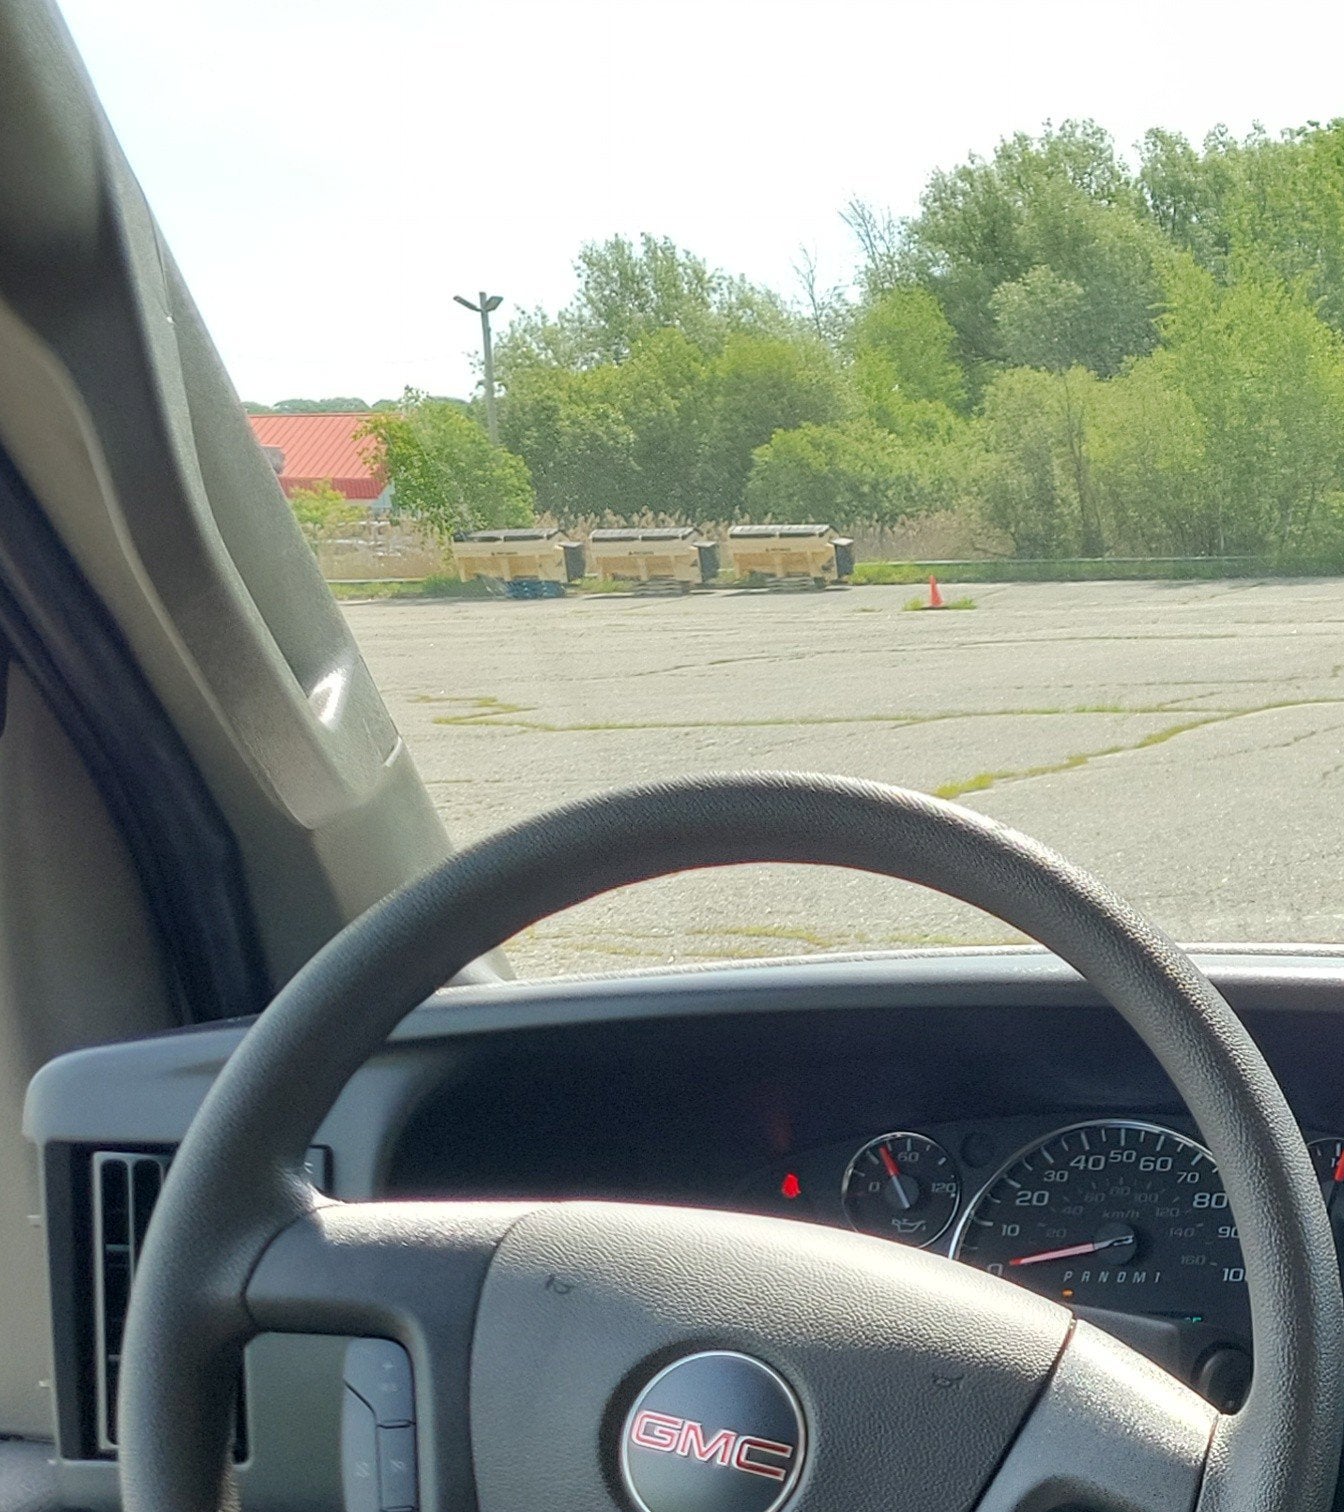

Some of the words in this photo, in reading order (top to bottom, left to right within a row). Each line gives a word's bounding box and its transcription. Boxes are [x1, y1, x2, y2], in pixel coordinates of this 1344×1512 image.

[897, 1151, 920, 1162] 60
[1070, 1155, 1106, 1171] 40
[1109, 1150, 1137, 1163] 50
[1139, 1157, 1173, 1172] 60
[1043, 1170, 1068, 1182] 30
[1177, 1171, 1200, 1184] 70
[931, 1182, 956, 1193] 120
[1015, 1191, 1049, 1206] 20
[1193, 1193, 1228, 1208] 80
[1102, 1209, 1140, 1219] km/h
[1001, 1224, 1020, 1236] 10
[631, 1410, 793, 1481] GMC
